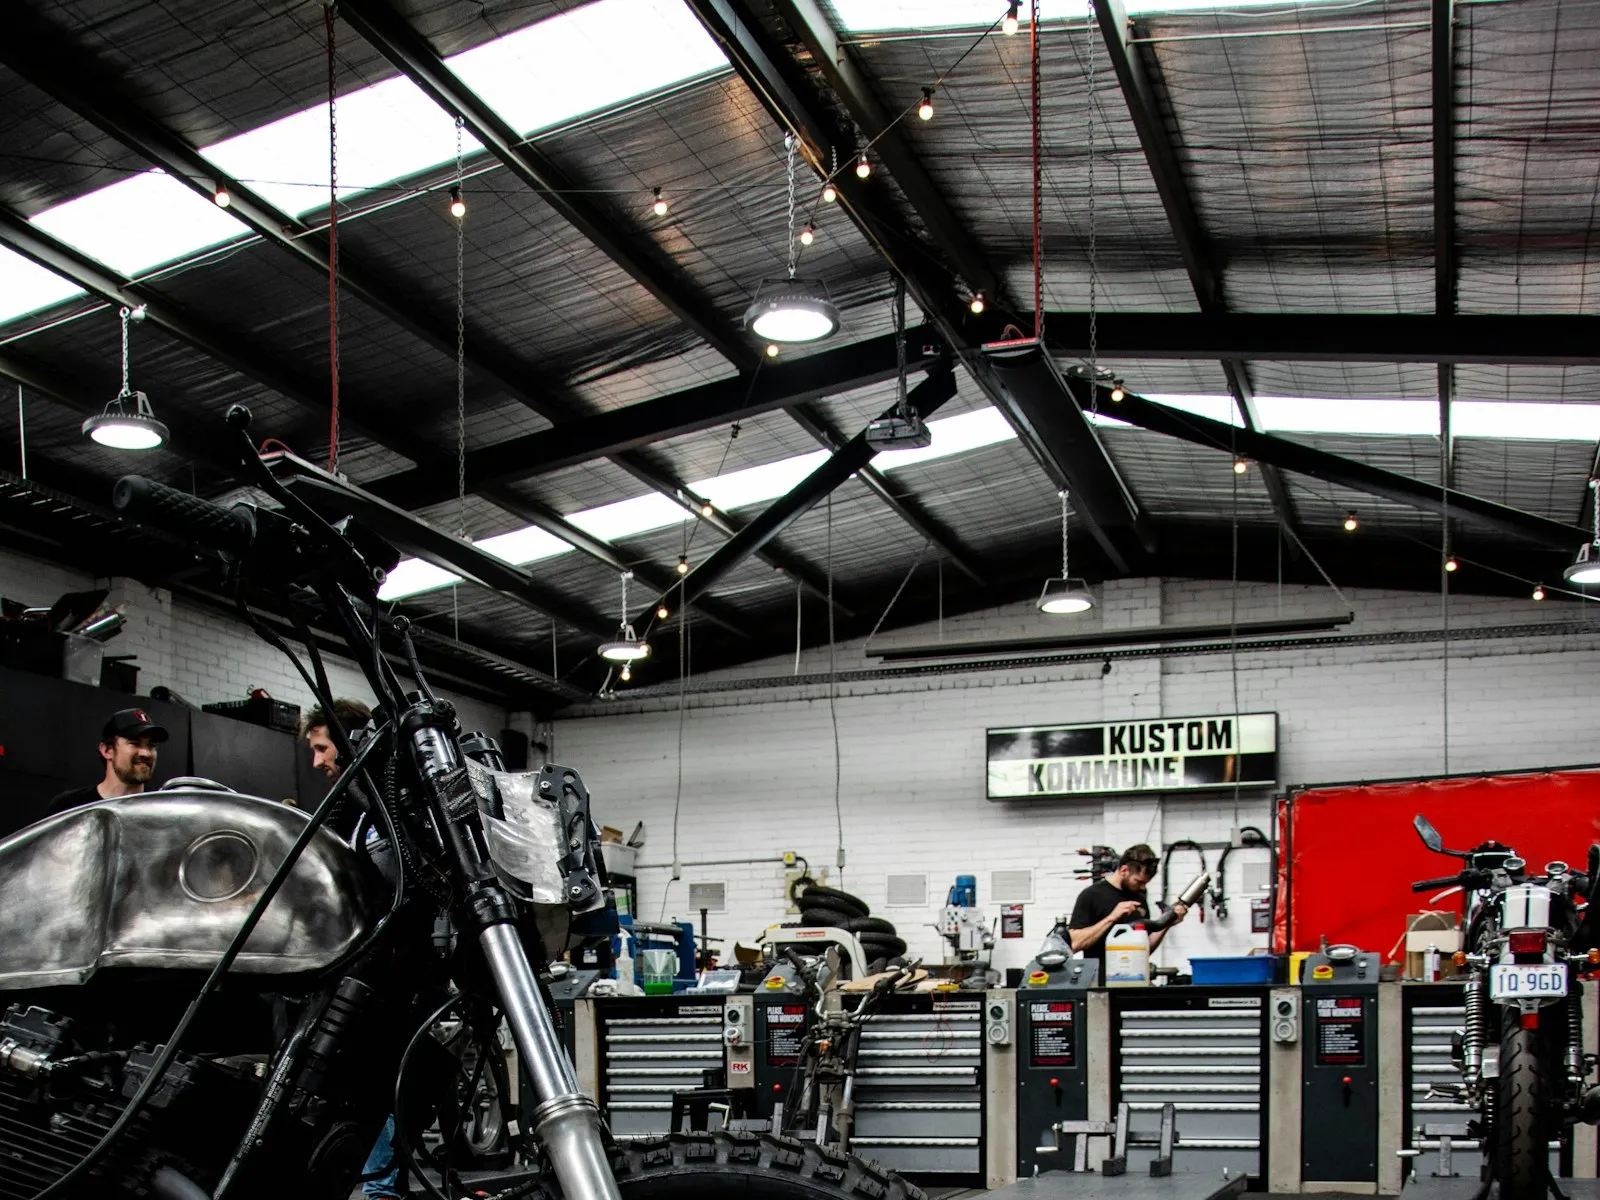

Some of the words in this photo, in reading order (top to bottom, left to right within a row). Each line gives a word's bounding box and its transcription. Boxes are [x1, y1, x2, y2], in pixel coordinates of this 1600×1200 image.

[1109, 719, 1233, 755] KUSTOM
[1028, 757, 1179, 793] KOMMUNE
[733, 1063, 748, 1071] RK
